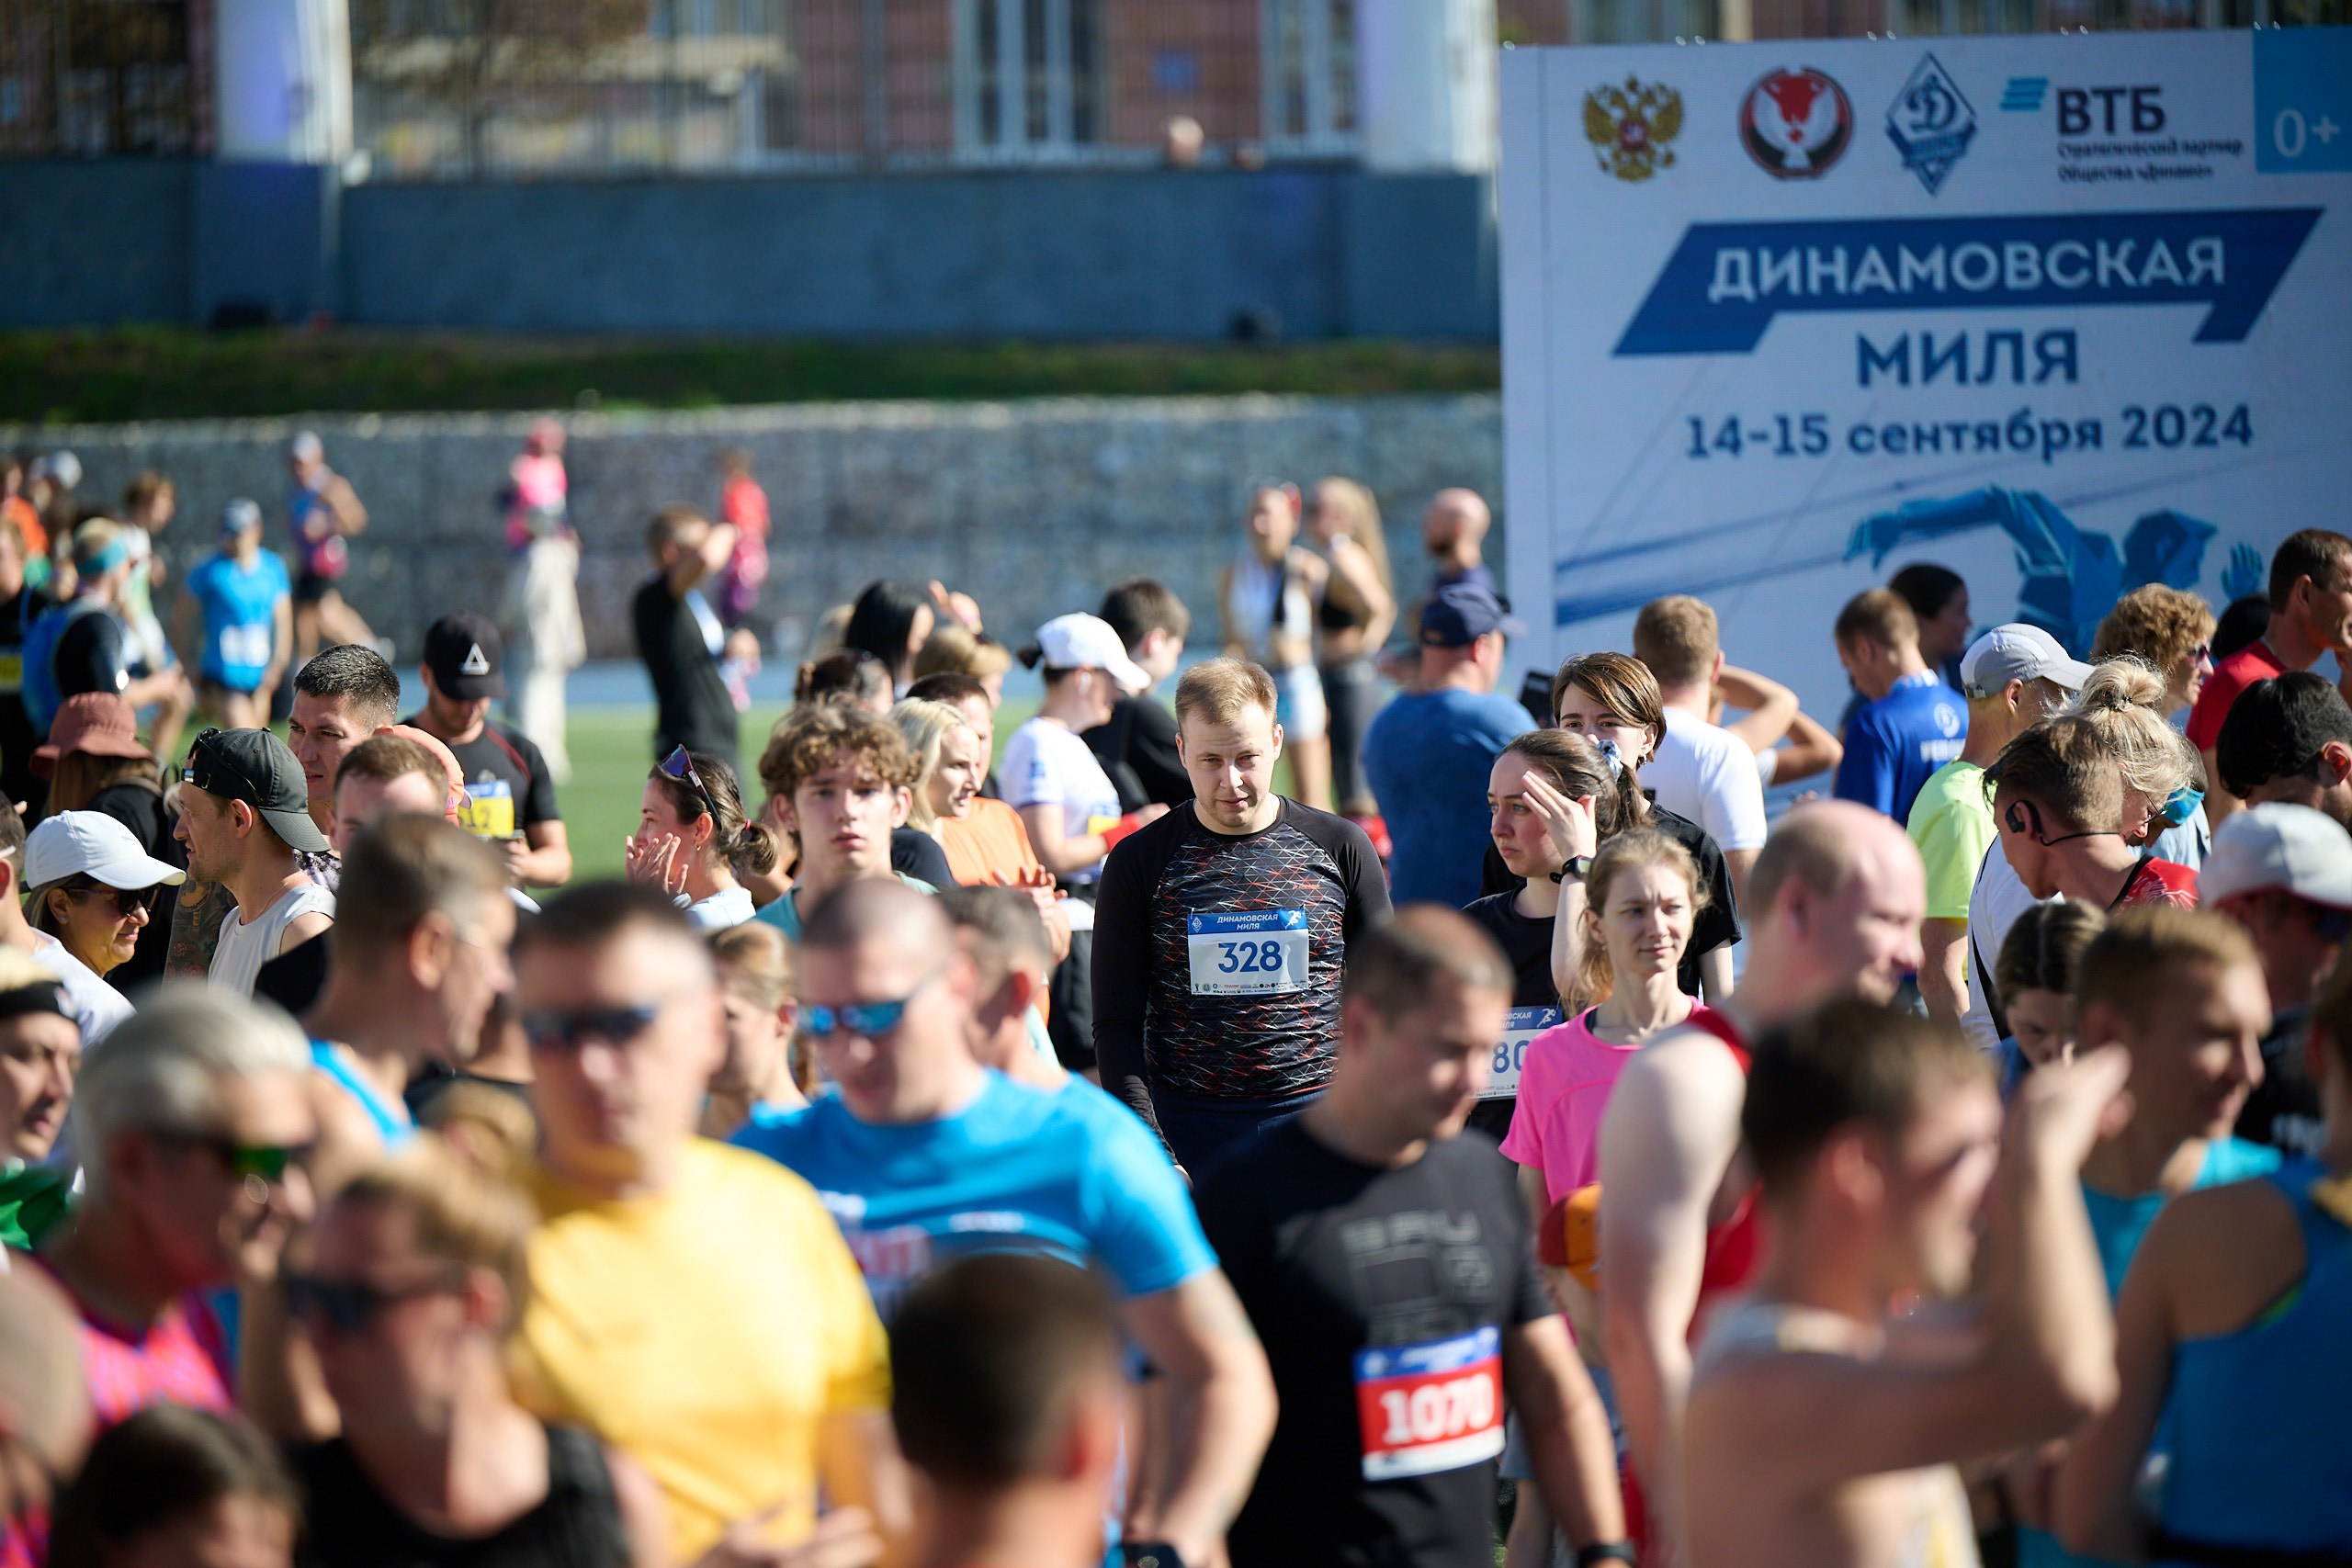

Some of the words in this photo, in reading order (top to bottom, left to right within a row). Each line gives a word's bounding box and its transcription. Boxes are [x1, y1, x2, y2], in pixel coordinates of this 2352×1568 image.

[2056, 85, 2166, 136] ВТБ
[2273, 108, 2340, 158] 0+
[1707, 236, 2225, 304] ДИНАМОВСКАЯ
[1856, 329, 2077, 388] МИЛЯ
[1687, 412, 1830, 458] 14-15
[1847, 407, 2102, 465] сентября
[2121, 402, 2253, 449] 2024
[1216, 913, 1279, 924] ДИНАМОВСКАЯ
[1237, 922, 1260, 931] МИЛЯ
[1217, 940, 1283, 974] 328
[1499, 1011, 1532, 1021] ОВСКАЯ
[1380, 1371, 1495, 1445] 1070
